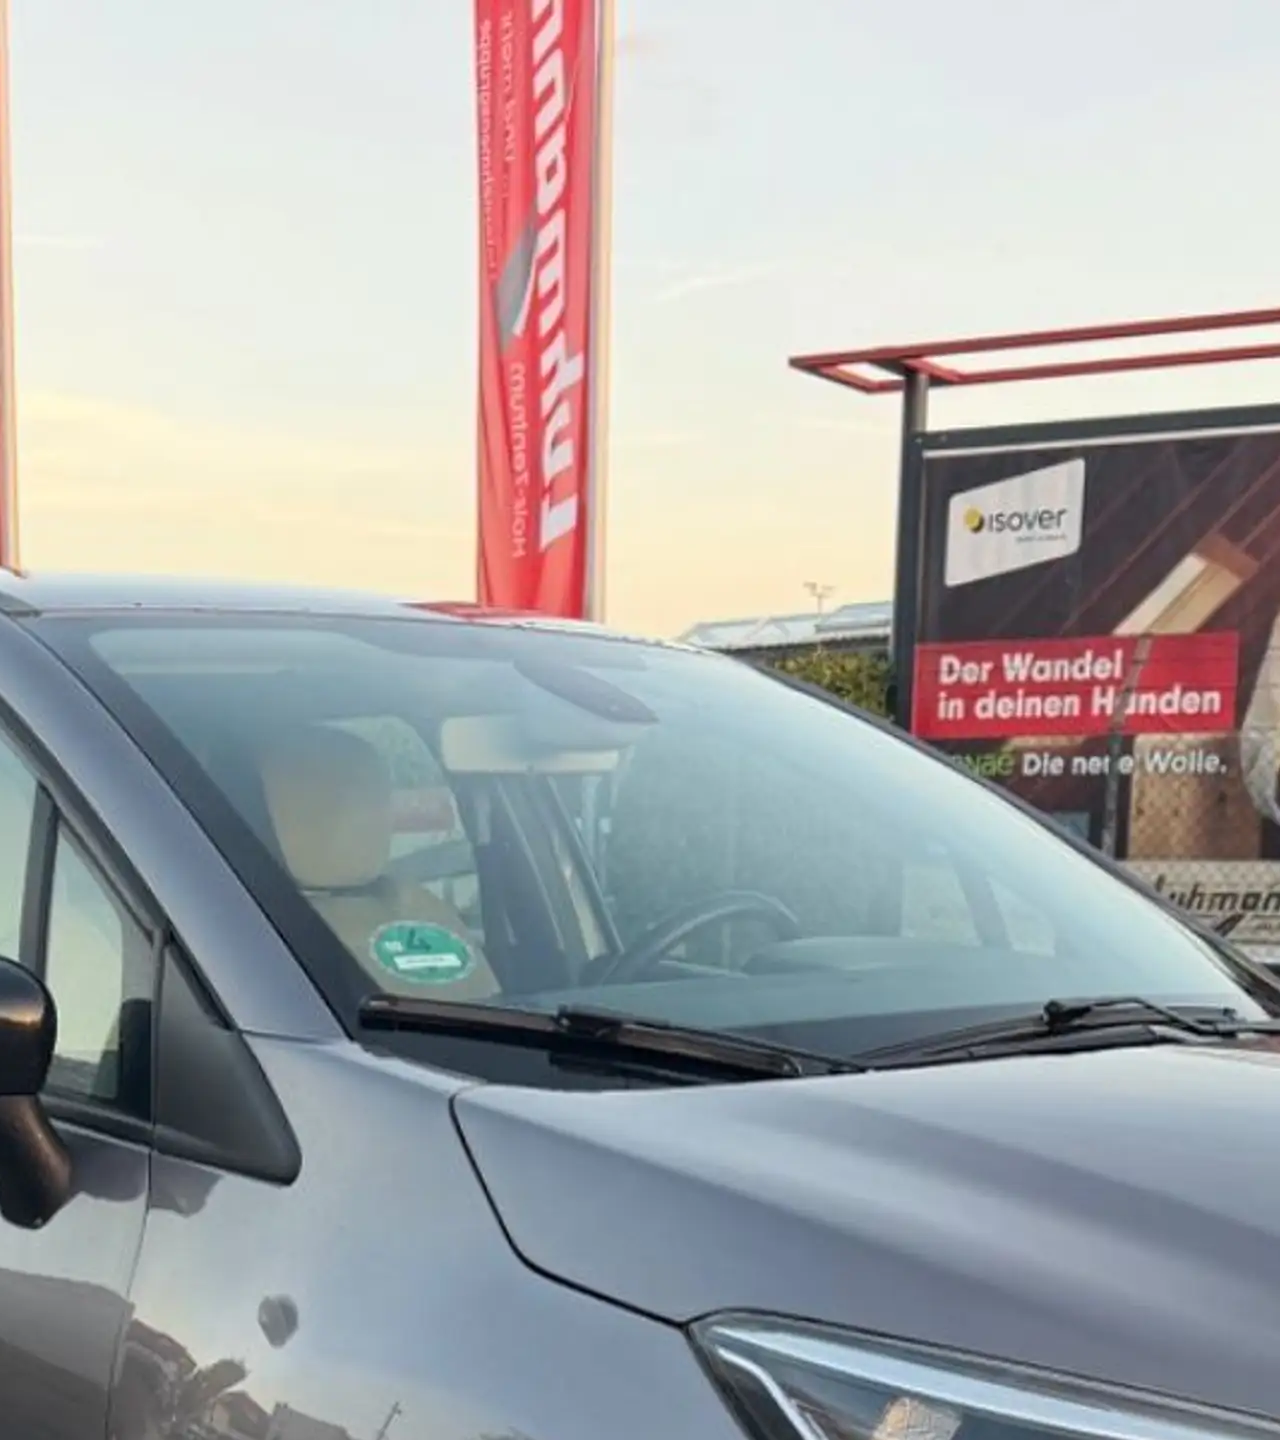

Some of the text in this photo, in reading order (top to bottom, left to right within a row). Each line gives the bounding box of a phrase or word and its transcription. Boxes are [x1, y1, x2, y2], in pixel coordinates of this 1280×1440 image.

[938, 649, 1124, 685] Der Wandel
[938, 692, 965, 720] in
[974, 689, 1080, 720] deinen
[1023, 752, 1064, 776] Die
[1144, 749, 1227, 775] Wolle.
